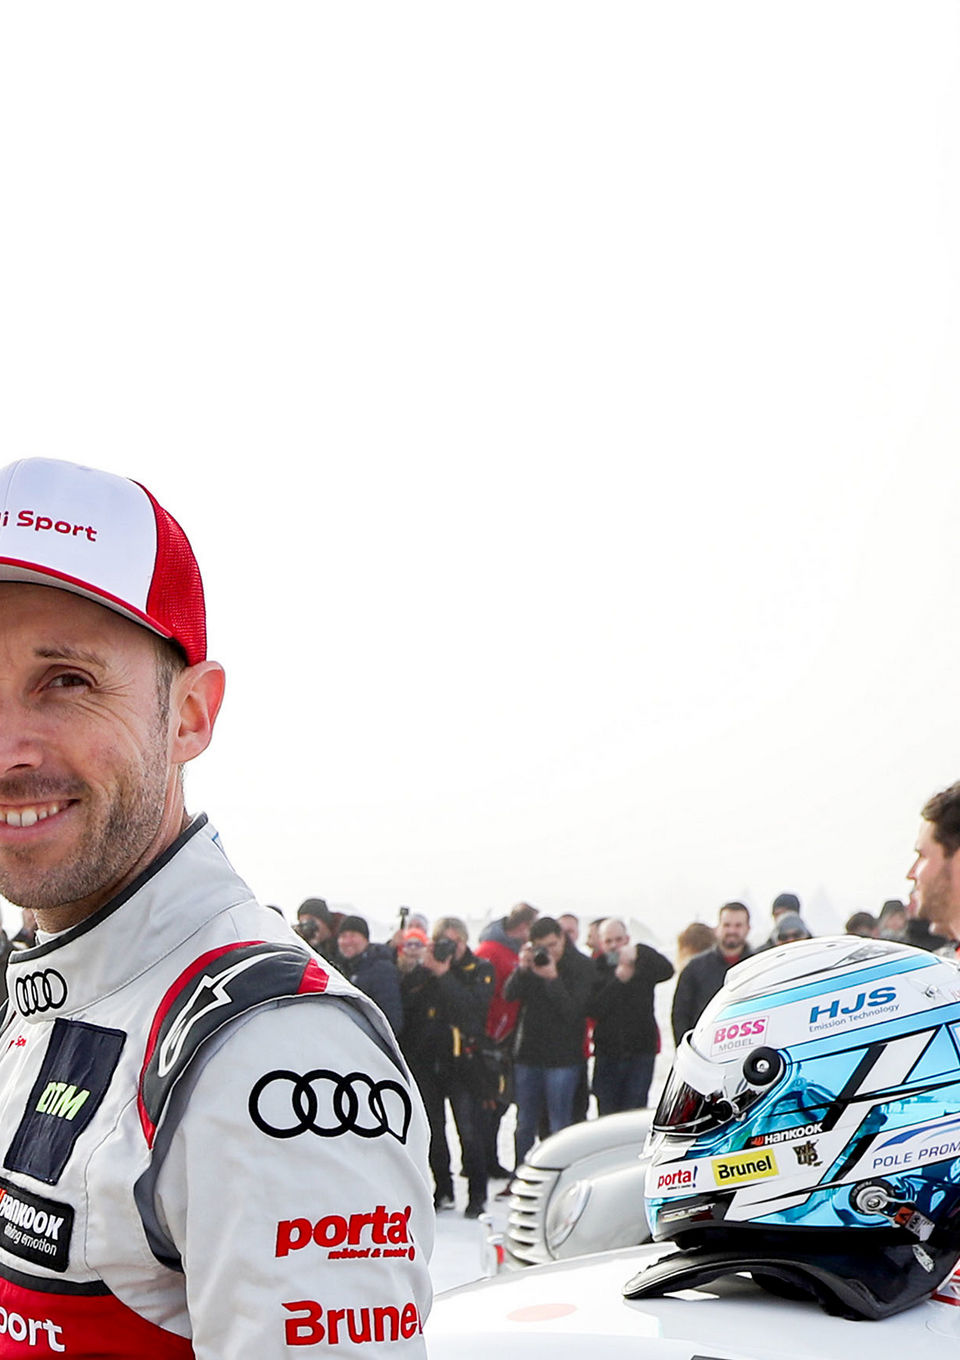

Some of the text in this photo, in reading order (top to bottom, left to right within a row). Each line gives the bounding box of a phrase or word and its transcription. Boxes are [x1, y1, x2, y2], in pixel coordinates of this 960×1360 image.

[16, 510, 98, 542] Sport
[808, 1004, 900, 1033] Emission Technology
[809, 986, 897, 1024] HJS
[713, 1018, 766, 1045] BOSS
[35, 1080, 90, 1121] DTM
[717, 1156, 772, 1179] Brunel
[872, 1152, 913, 1169] POLE
[657, 1165, 698, 1189] porta!
[21, 1233, 58, 1257] emotion
